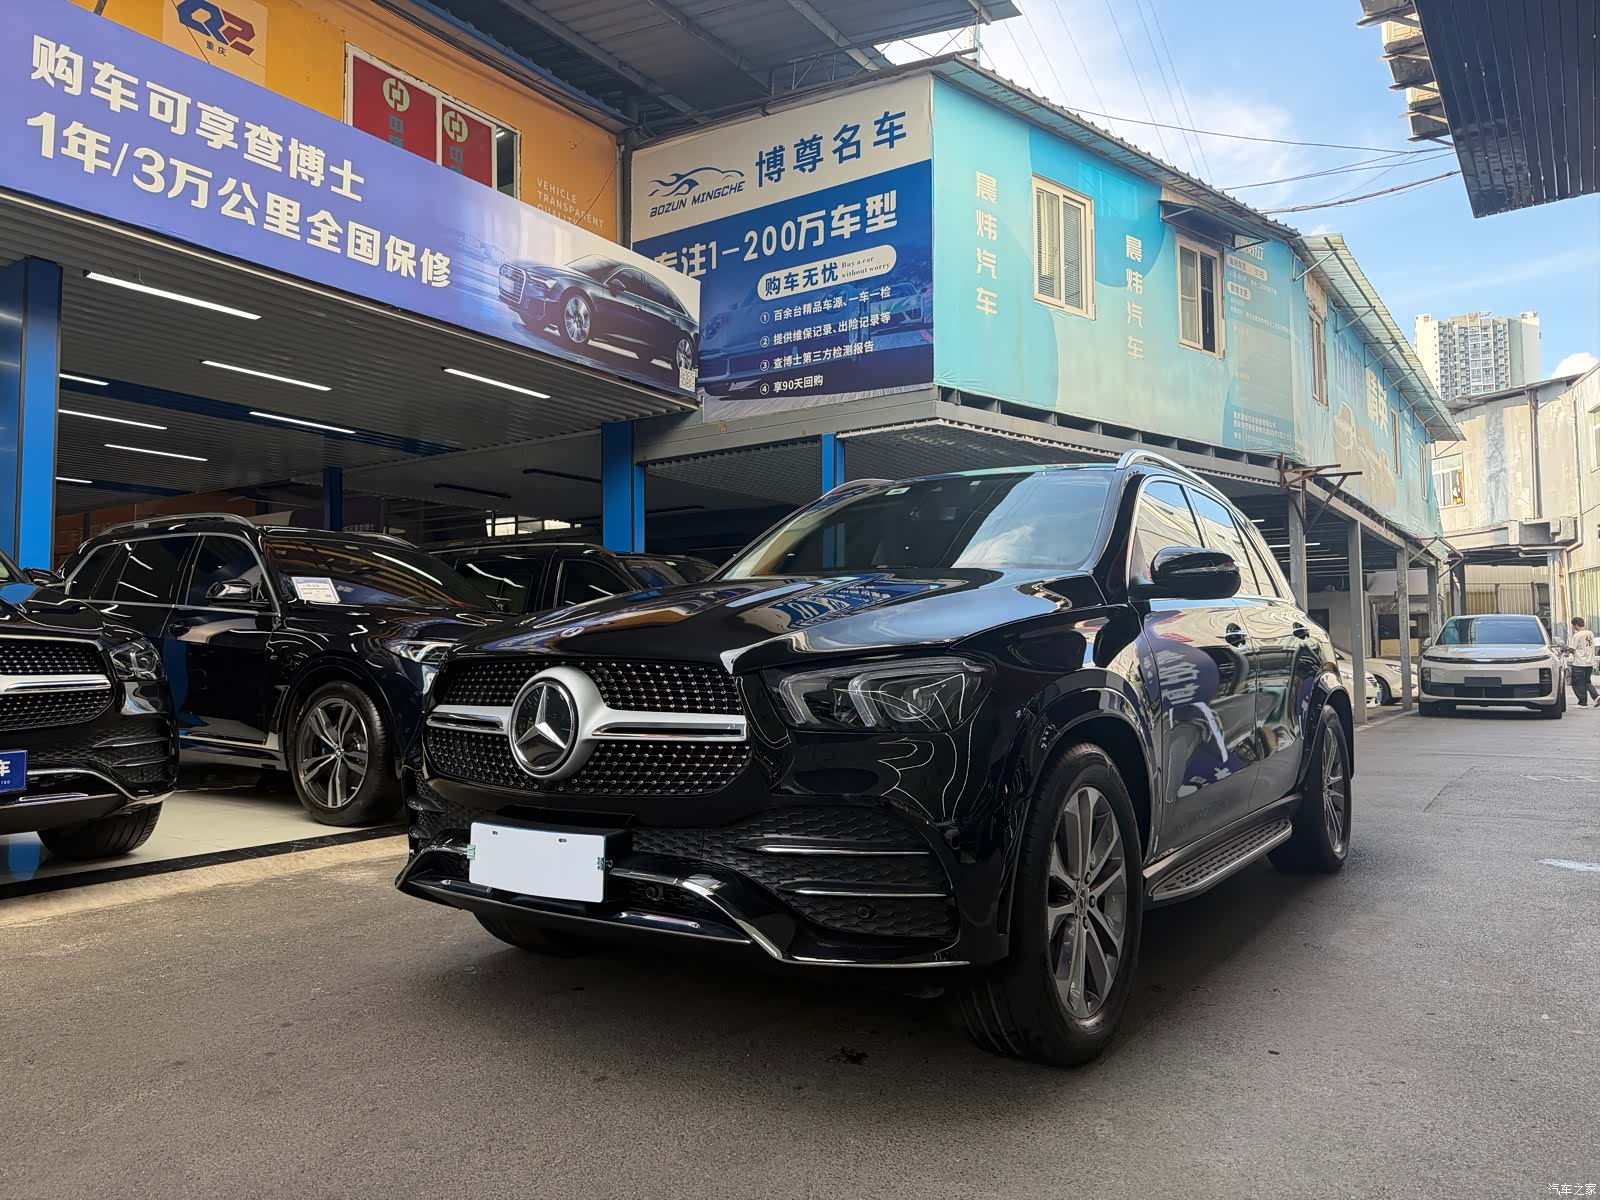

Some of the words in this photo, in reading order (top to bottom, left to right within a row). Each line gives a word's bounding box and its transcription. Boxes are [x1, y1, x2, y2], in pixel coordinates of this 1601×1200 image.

[30, 34, 365, 202] 购车可享查博士
[755, 111, 907, 188] 博尊名车
[26, 111, 451, 288] 1年/3万公里全国保修
[537, 177, 577, 204] VEHICLE
[691, 180, 746, 206] MINGCHE
[537, 190, 604, 228] TRANSPARENT
[975, 170, 998, 316] 晨炜汽车
[765, 261, 838, 297] 购车无忧
[842, 267, 868, 278] without
[773, 285, 892, 322] 百余台精品车源、一车一检
[1126, 234, 1144, 361] 晨炜汽车
[773, 311, 892, 347] 提供维保记录、出险记录等
[773, 340, 875, 371] 查博士第三方检测报告
[773, 374, 824, 394] 享90天回购
